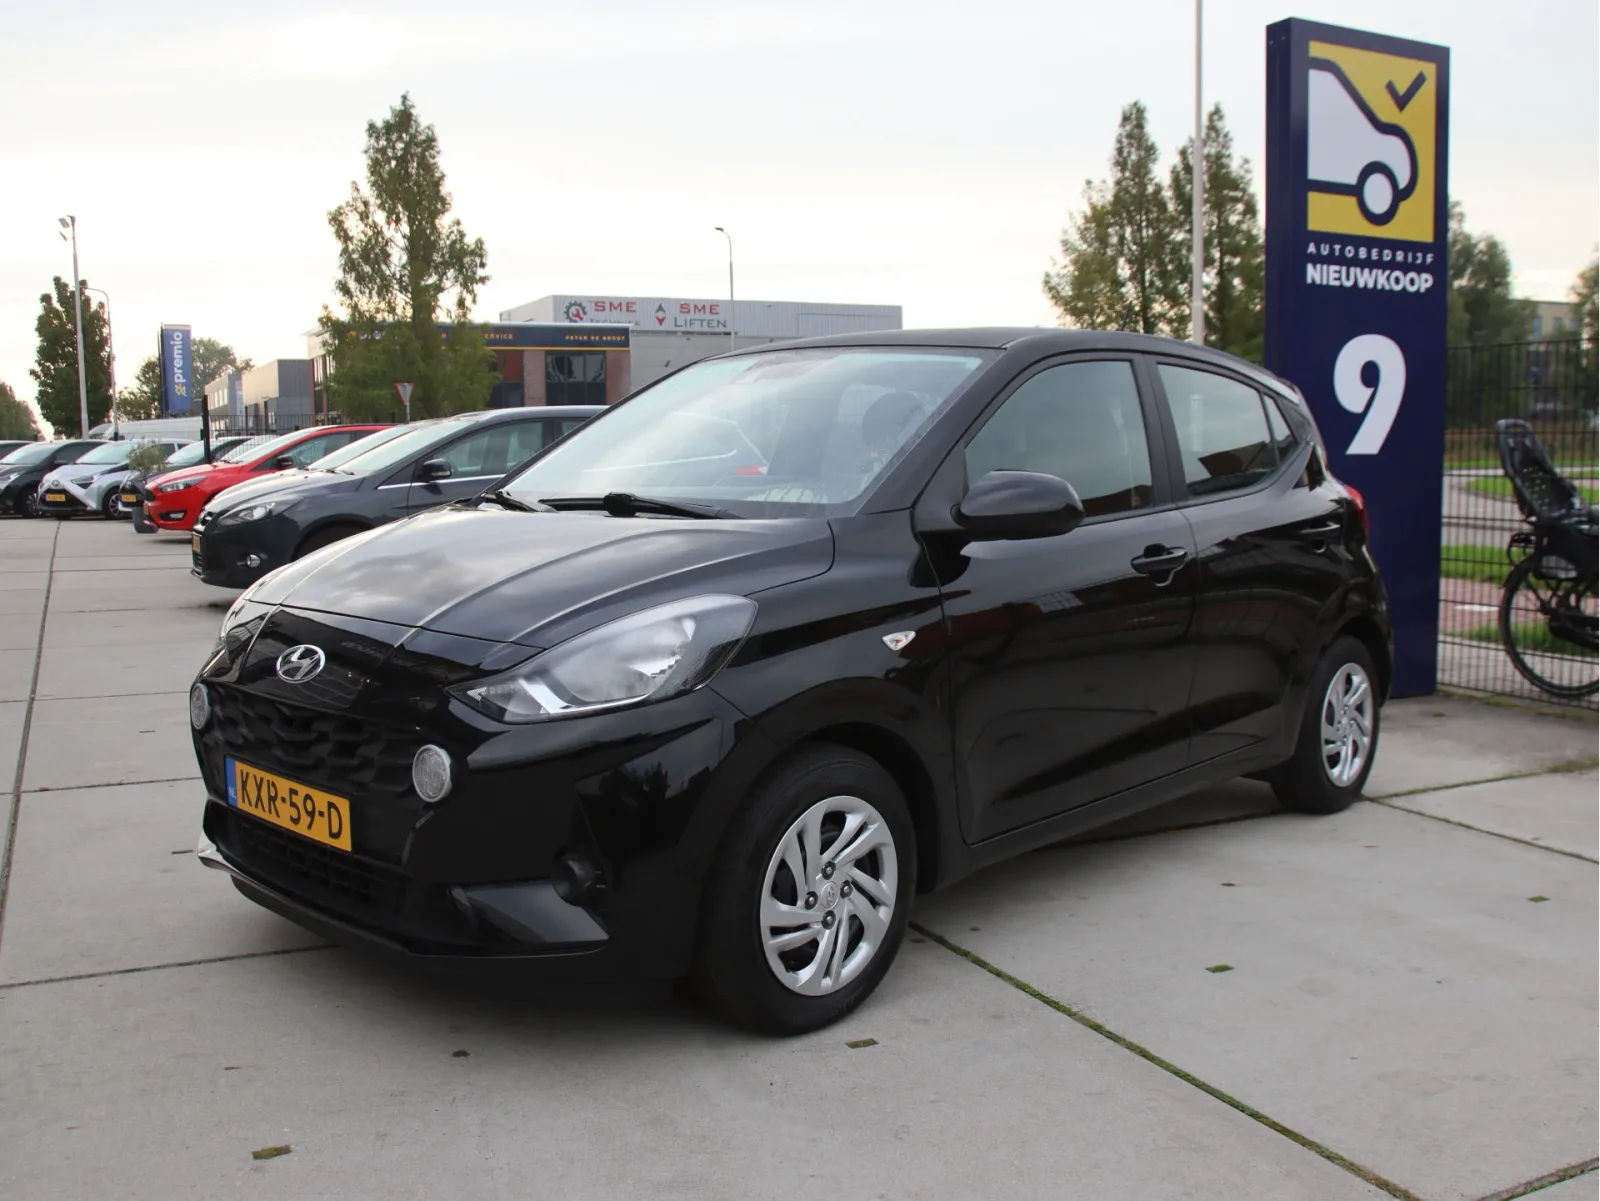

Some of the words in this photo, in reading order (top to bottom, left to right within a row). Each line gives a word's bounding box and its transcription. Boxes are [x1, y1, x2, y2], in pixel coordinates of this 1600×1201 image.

[1306, 242, 1434, 265] AUTOBEDRIJF
[1306, 262, 1434, 293] NIEUWKOOP
[594, 300, 637, 313] SME
[679, 302, 720, 315] SME
[674, 316, 727, 328] LIFTEN
[170, 331, 186, 383] premio
[1333, 333, 1407, 455] 9
[240, 768, 343, 840] KXR-59-D
